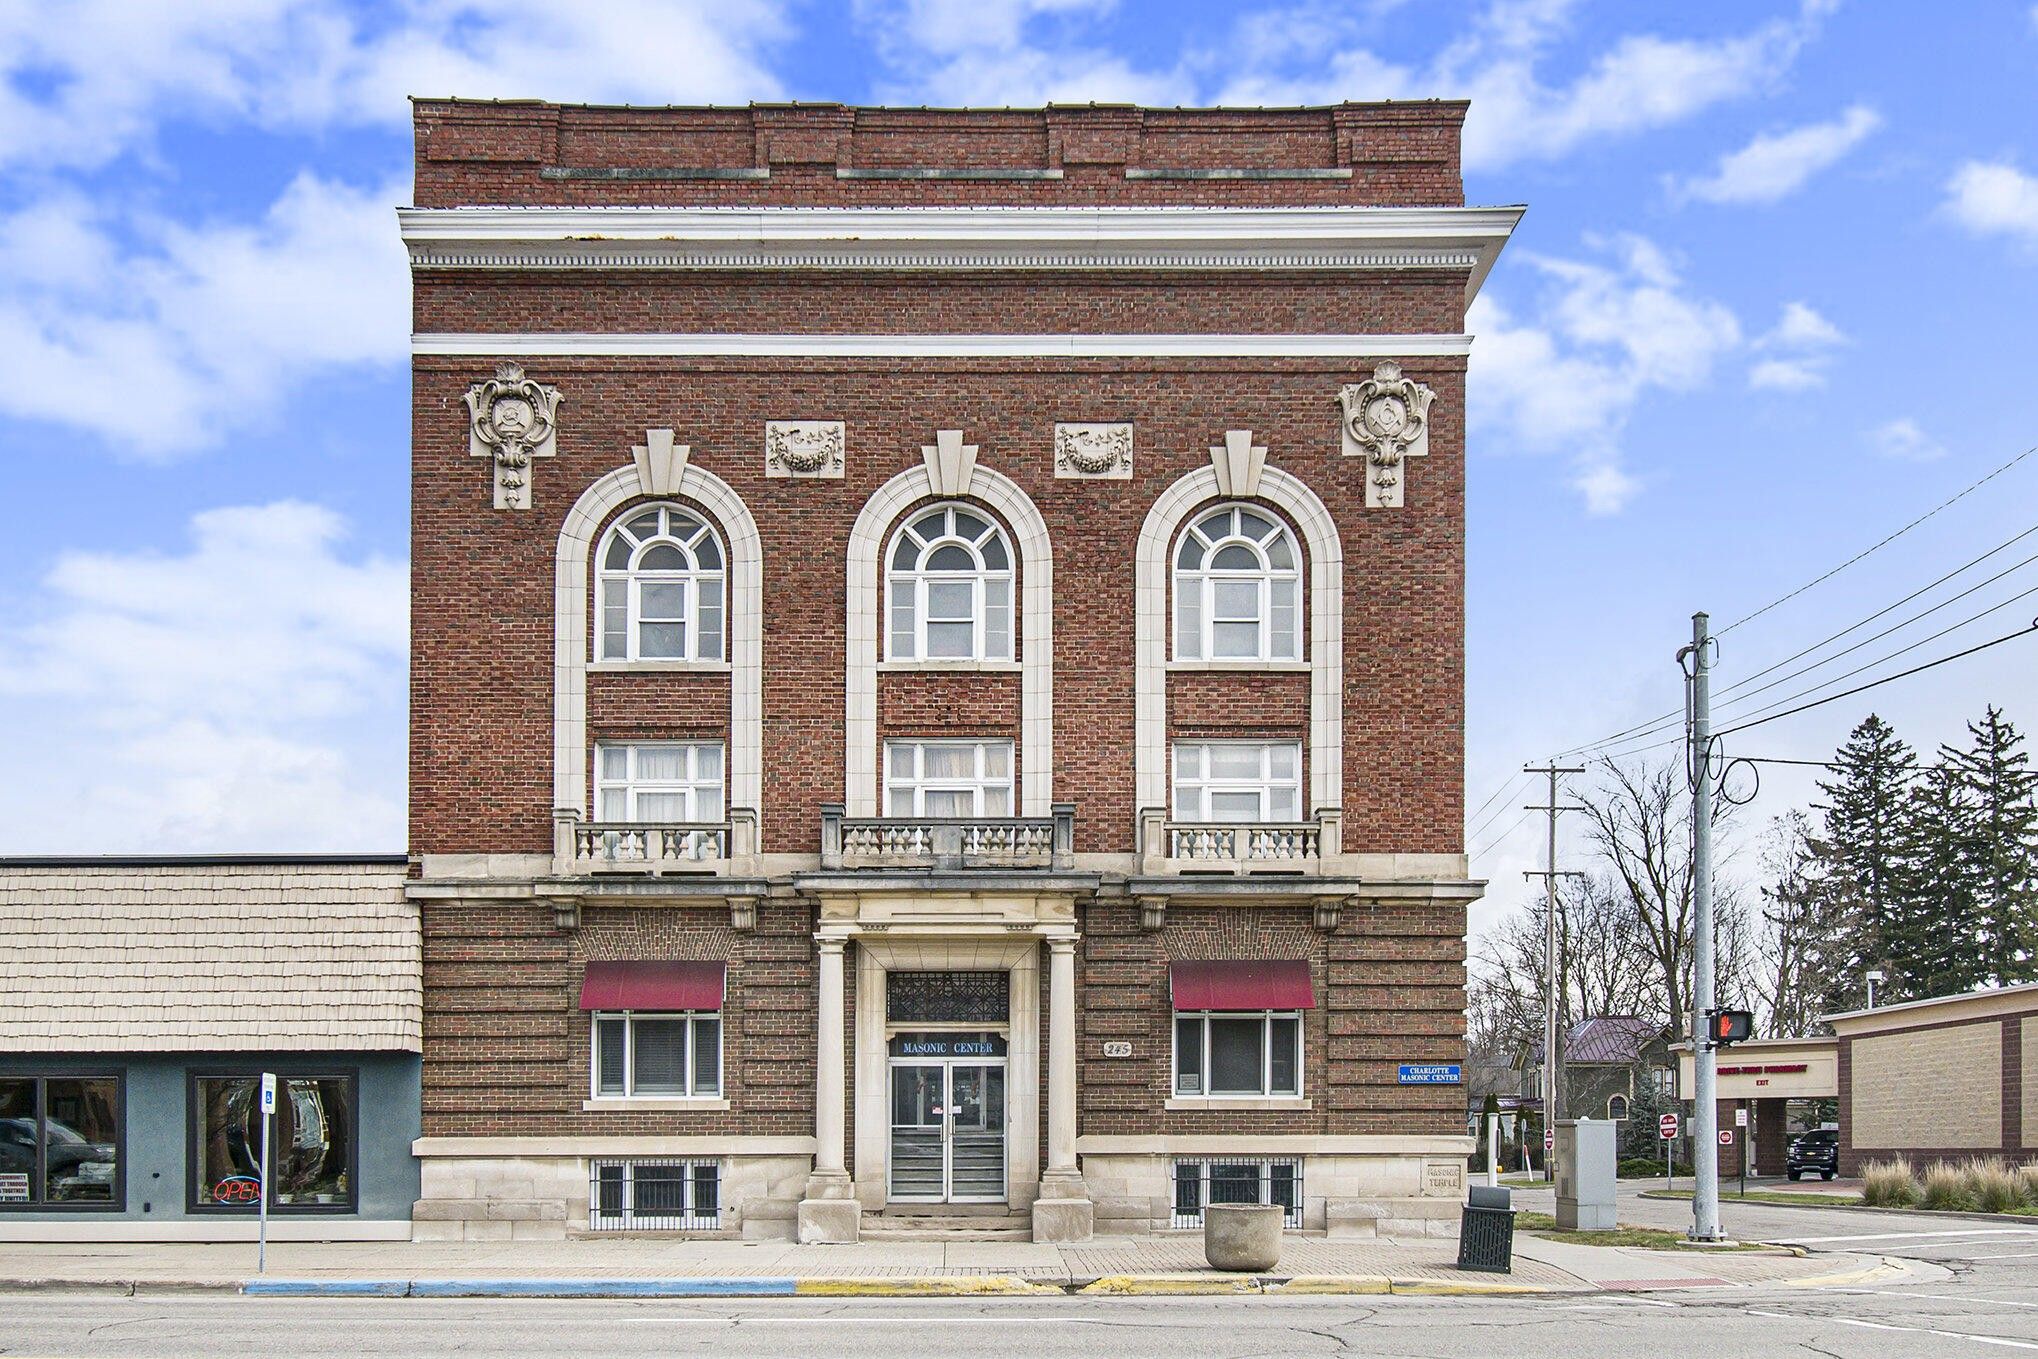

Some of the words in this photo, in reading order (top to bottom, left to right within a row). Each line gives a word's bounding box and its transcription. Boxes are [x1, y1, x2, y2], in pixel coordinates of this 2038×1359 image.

[903, 1042, 947, 1053] MASONIC
[953, 1042, 993, 1053] CENTER
[1107, 1044, 1129, 1055] 245
[1429, 1179, 1458, 1187] TEMPLE
